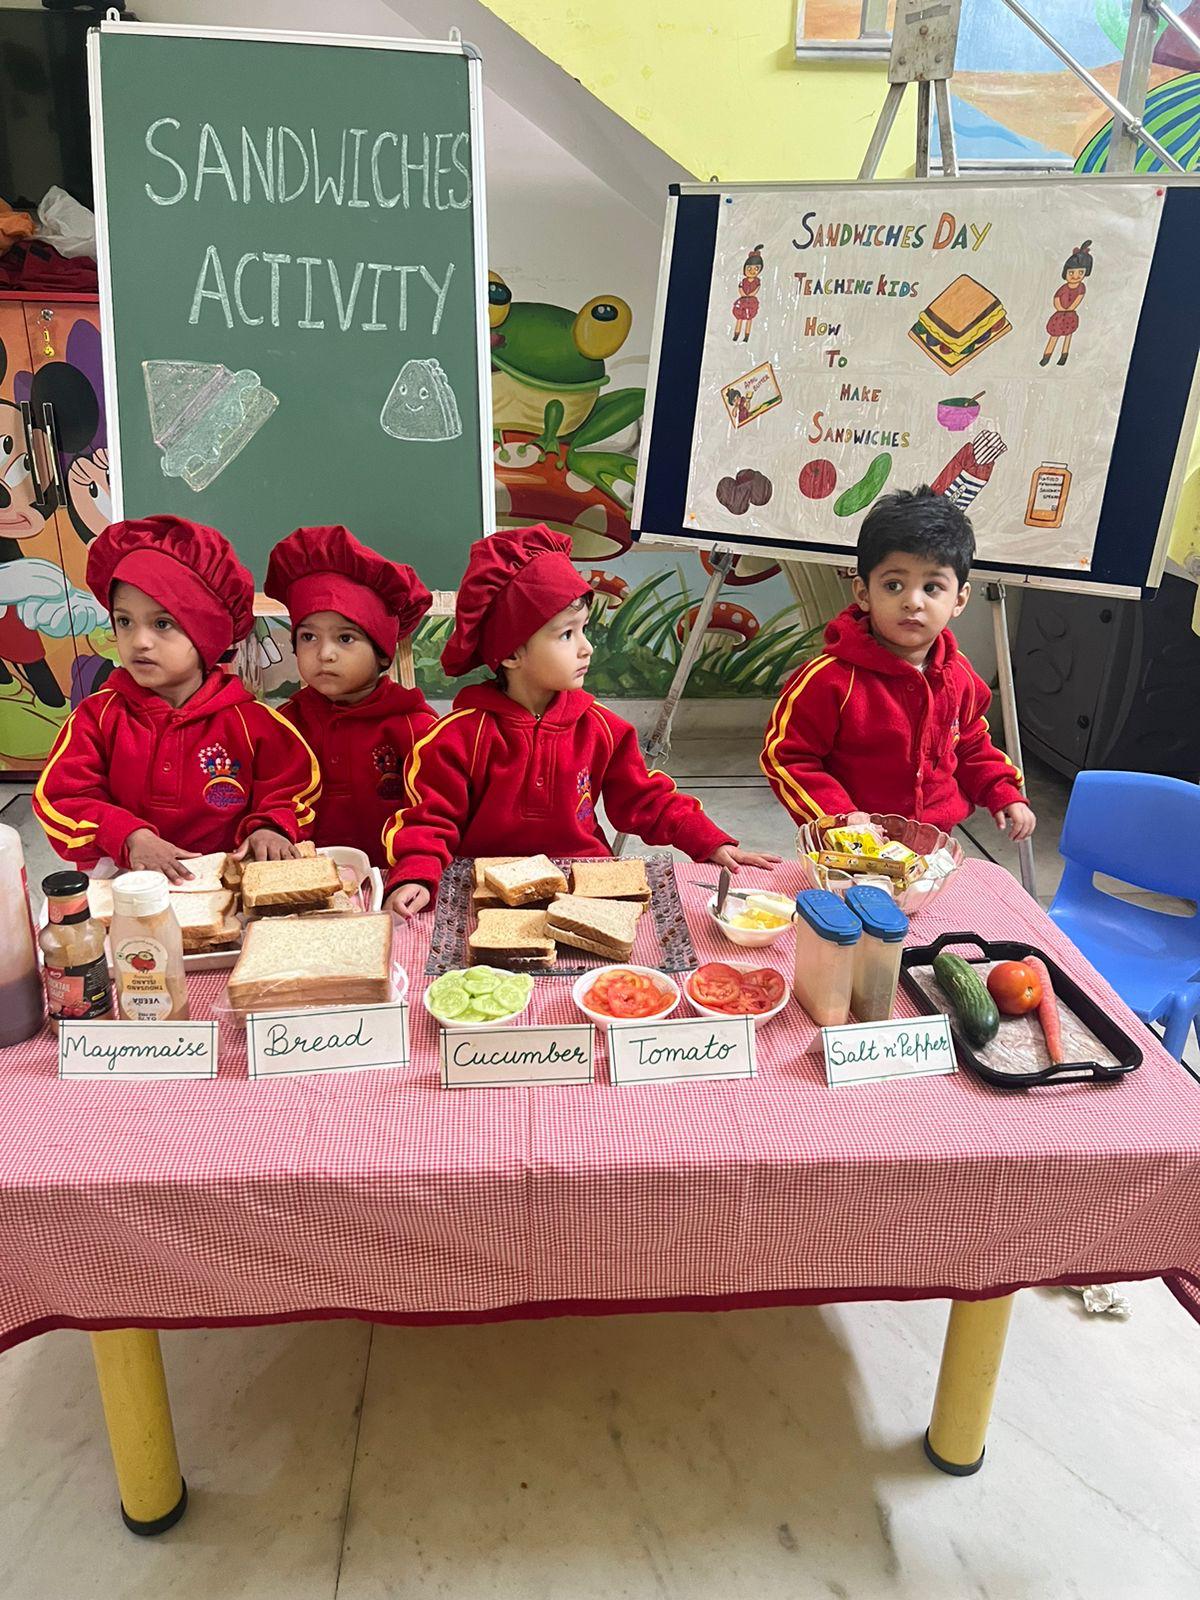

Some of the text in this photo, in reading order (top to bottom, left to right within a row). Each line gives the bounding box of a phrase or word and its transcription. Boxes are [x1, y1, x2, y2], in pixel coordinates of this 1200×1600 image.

[144, 117, 472, 210] SANDWICHES
[792, 212, 992, 251] SANDWICHES DAY
[188, 245, 455, 335] ACTIVITY
[808, 411, 910, 448] SANDWICHES
[63, 1035, 208, 1071] Mayonnaise
[264, 1018, 373, 1056] Bread
[453, 1041, 588, 1067] Cucumber
[629, 1034, 737, 1066] Tomato
[830, 1040, 879, 1065] Salt
